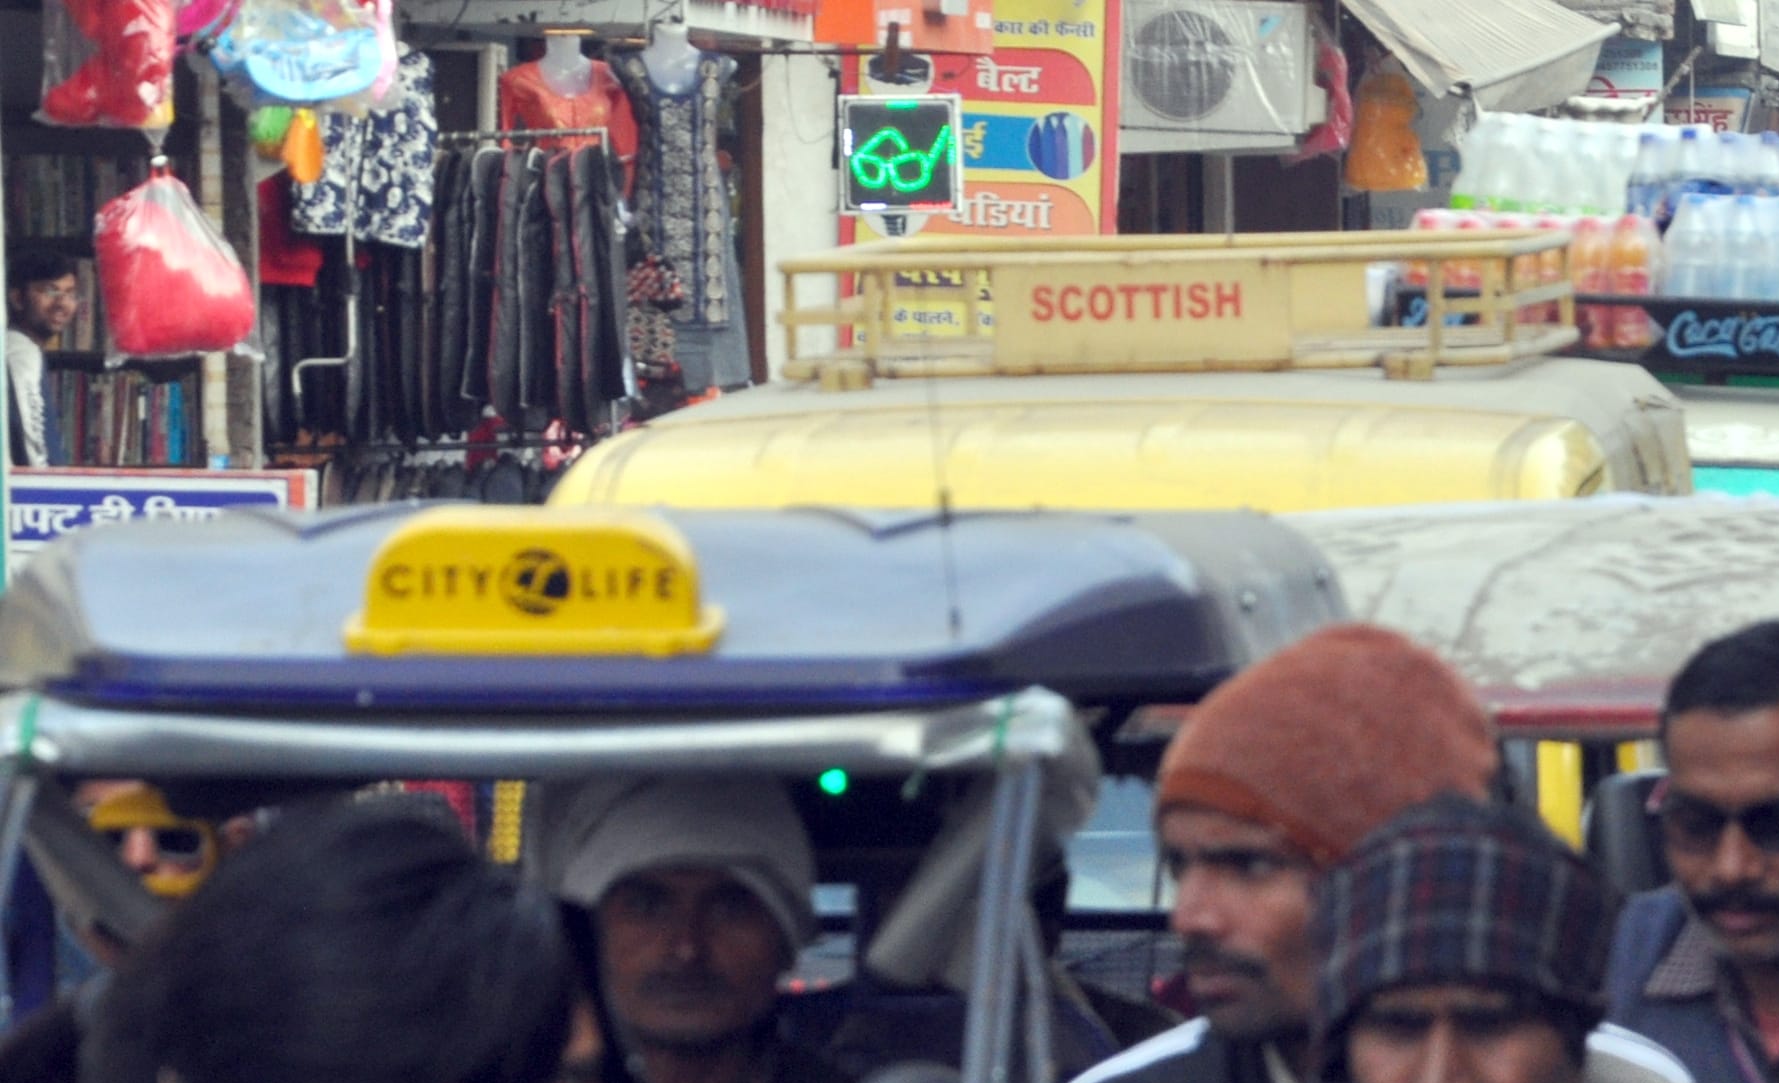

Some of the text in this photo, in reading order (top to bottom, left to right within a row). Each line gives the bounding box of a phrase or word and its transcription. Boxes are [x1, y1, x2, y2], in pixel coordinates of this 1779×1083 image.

[976, 57, 1041, 94] बैल्ट
[1031, 281, 1243, 322] SCOTTISH
[379, 563, 675, 600] CITY LIFE
